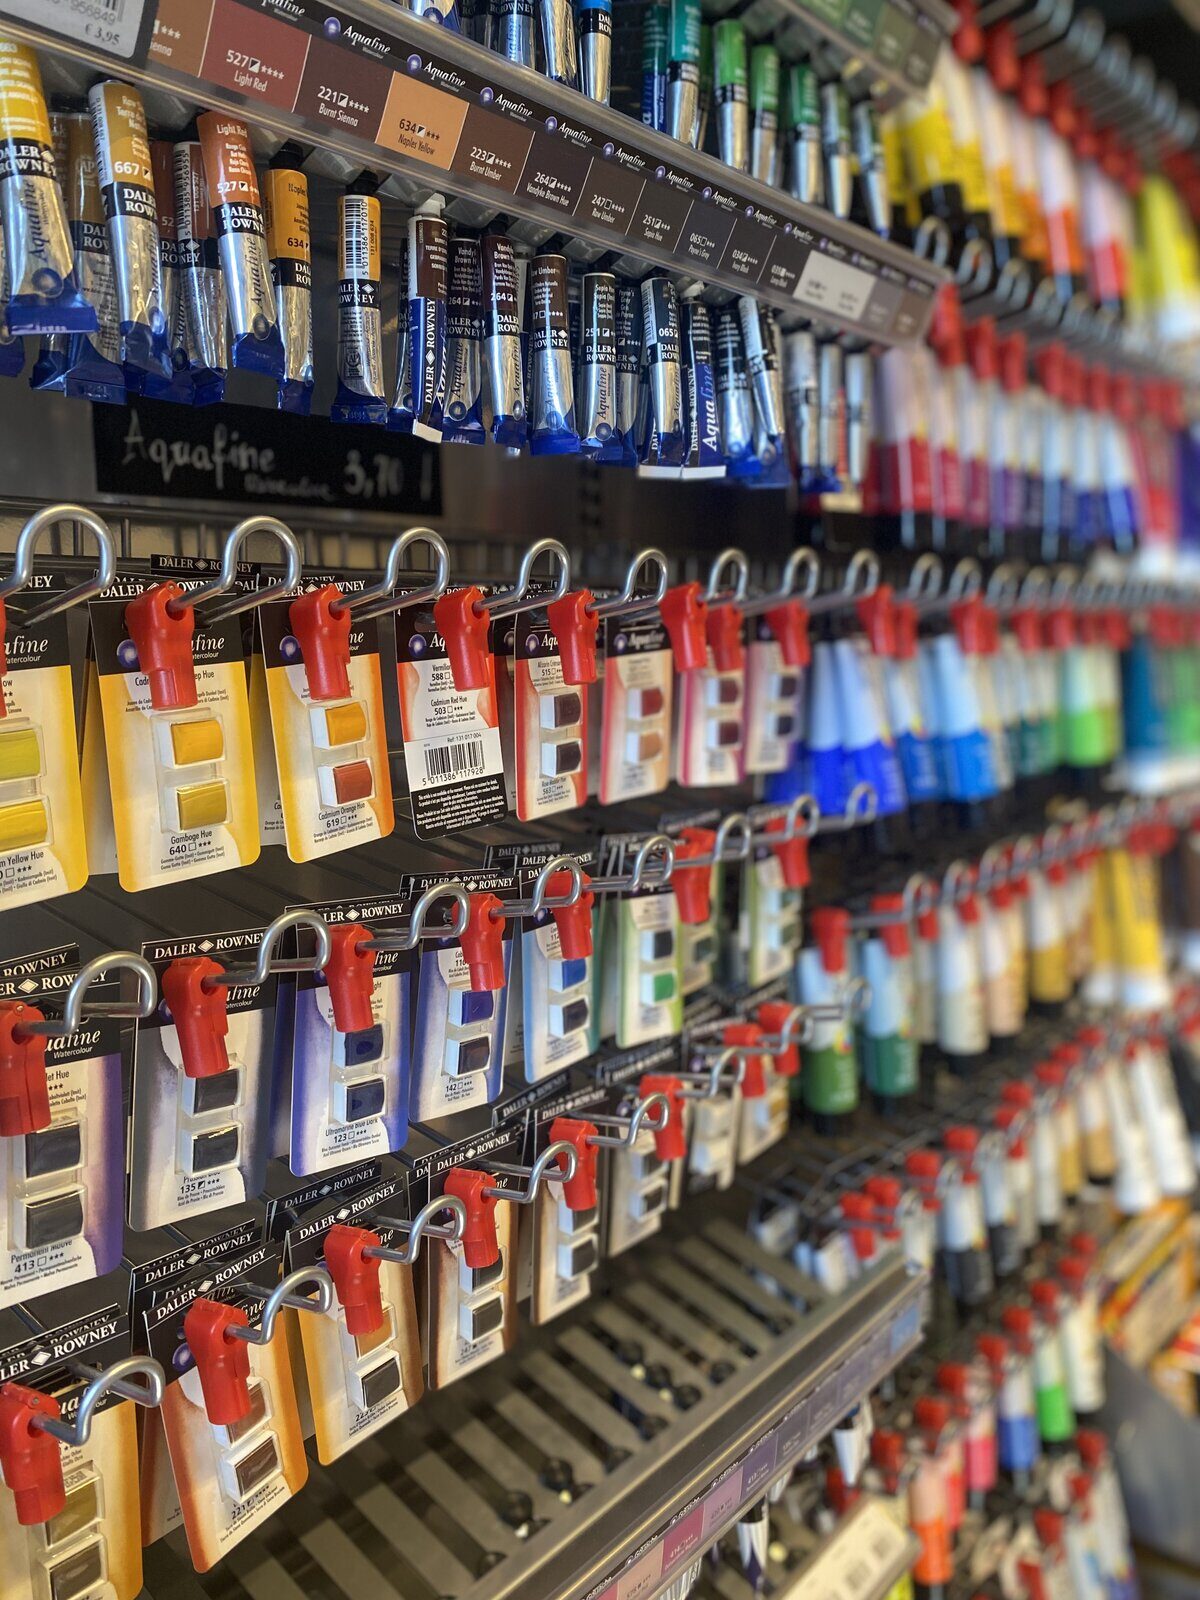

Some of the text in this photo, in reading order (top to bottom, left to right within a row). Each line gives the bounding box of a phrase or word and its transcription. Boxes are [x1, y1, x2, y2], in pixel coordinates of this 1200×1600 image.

[150, 38, 174, 57] ienna
[344, 25, 391, 55] Aquafine
[226, 49, 249, 69] 527
[234, 70, 268, 92] Light Red
[423, 61, 466, 87] Aquafine
[317, 85, 338, 103] 221
[495, 93, 533, 117] Aquafine
[318, 102, 359, 127] Burnt Sienna
[217, 123, 236, 136] Light
[399, 118, 417, 134] 634
[558, 122, 593, 144] Aquafine
[397, 133, 436, 155] Naples Yellow
[470, 146, 487, 162] 223
[615, 147, 646, 167] Aquafine
[114, 161, 140, 176] 667
[469, 161, 502, 181] Burnt Umber
[217, 181, 237, 194] 527
[534, 172, 550, 187] 264
[666, 170, 694, 189] Aquafine
[123, 188, 156, 208] DALE
[526, 182, 570, 207] Vandyke Brown Hue
[591, 194, 606, 208] 247
[712, 190, 738, 208] Aquafine
[221, 206, 259, 219] DALER
[601, 210, 616, 224] Umber
[643, 214, 656, 227] 251
[287, 237, 304, 248] 634
[689, 232, 701, 244] 065
[245, 237, 266, 309] Aquafine
[295, 262, 311, 273] DAL
[338, 283, 360, 293] ALER
[338, 293, 375, 304] OWNEY
[490, 293, 506, 301] 264
[497, 314, 519, 324] DALE
[659, 328, 673, 337] 065
[425, 298, 436, 404] DALER ROWNEY
[586, 345, 612, 354] DALER
[451, 341, 466, 398] Aquafine
[597, 367, 607, 419] Aquafine
[688, 368, 697, 407] ROWNEY
[700, 365, 720, 452] Aquafine
[121, 408, 276, 490] Aquafine
[158, 555, 254, 573] DALER RONEY
[28, 574, 53, 589] NEY
[99, 583, 145, 599] DALER
[202, 670, 215, 679] Hue
[431, 672, 444, 681] 588
[430, 696, 468, 707] Cadmium Red Hue
[434, 707, 447, 716] 503
[430, 774, 457, 785] 011386
[459, 767, 484, 779] 117928
[318, 801, 366, 821] Cadmium Orange Hue
[326, 817, 340, 829] 619
[170, 830, 213, 845] Gamboge Hue
[6, 850, 44, 866] Yellow Hue
[169, 844, 187, 856] 640
[522, 855, 547, 866] DALER
[478, 877, 514, 890] ROWNEY
[323, 903, 404, 923] LER ROWNEY
[154, 943, 197, 960] DALER
[374, 949, 399, 966] fine
[46, 1029, 101, 1051] uafine
[53, 1045, 93, 1060] Watercolour
[55, 1069, 70, 1080] Hue
[445, 1083, 457, 1092] 142
[334, 1133, 347, 1144] 123
[437, 1131, 511, 1172] DALER ROWNEY
[180, 1182, 196, 1194] 135
[284, 1167, 376, 1209] DALER ROWNEY
[299, 1183, 396, 1240] DALER ROWNEY
[144, 1231, 254, 1284] DALER ROWNEY
[14, 1260, 35, 1273] 413
[156, 1248, 267, 1321] DALER ROWNEY
[0, 1320, 118, 1381] LER ROWNEY
